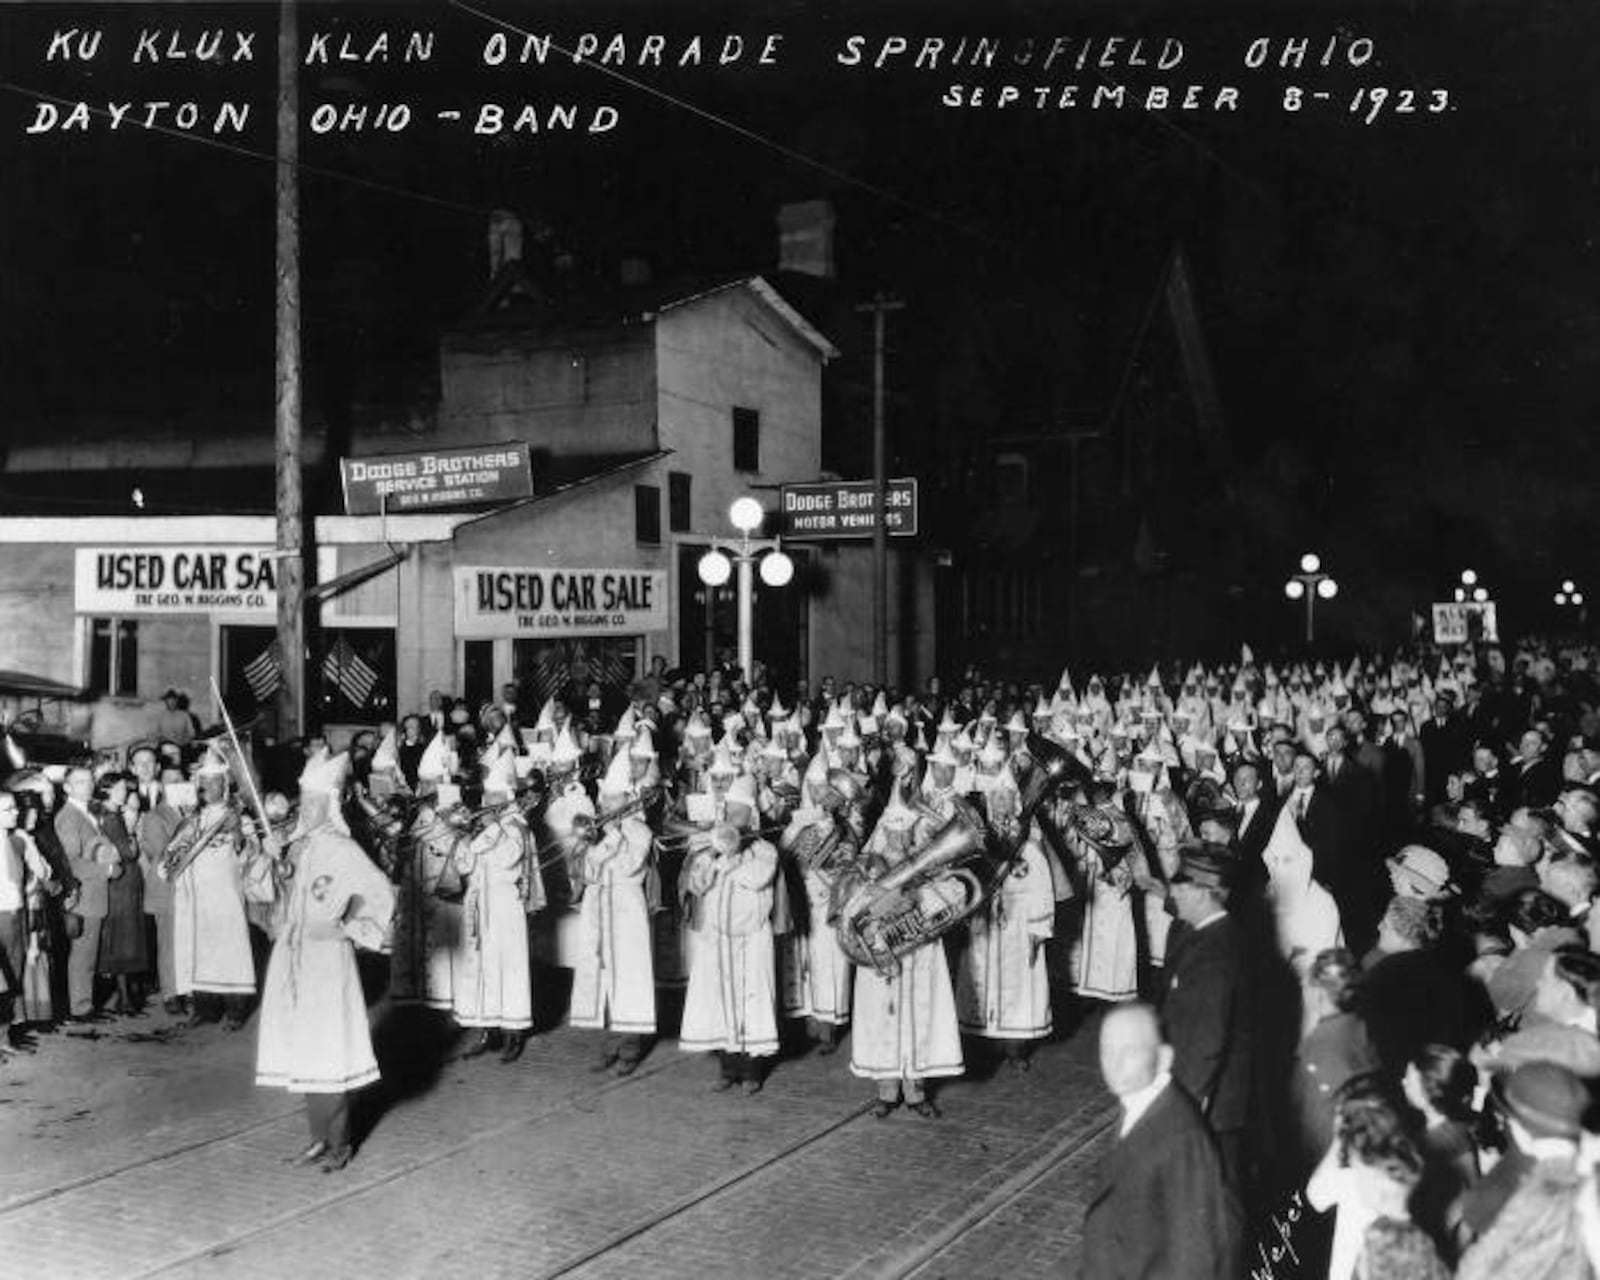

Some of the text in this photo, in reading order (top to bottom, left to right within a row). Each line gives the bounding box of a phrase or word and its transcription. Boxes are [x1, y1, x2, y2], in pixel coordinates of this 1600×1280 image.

[350, 452, 520, 481] DODGE BROTHERS
[376, 470, 500, 495] SERVICE STATION
[785, 490, 912, 512] DODGE BROTERS
[794, 514, 836, 529] MOTOR
[97, 553, 276, 590] USED CAR SA
[477, 572, 652, 612] USED CAR SALE
